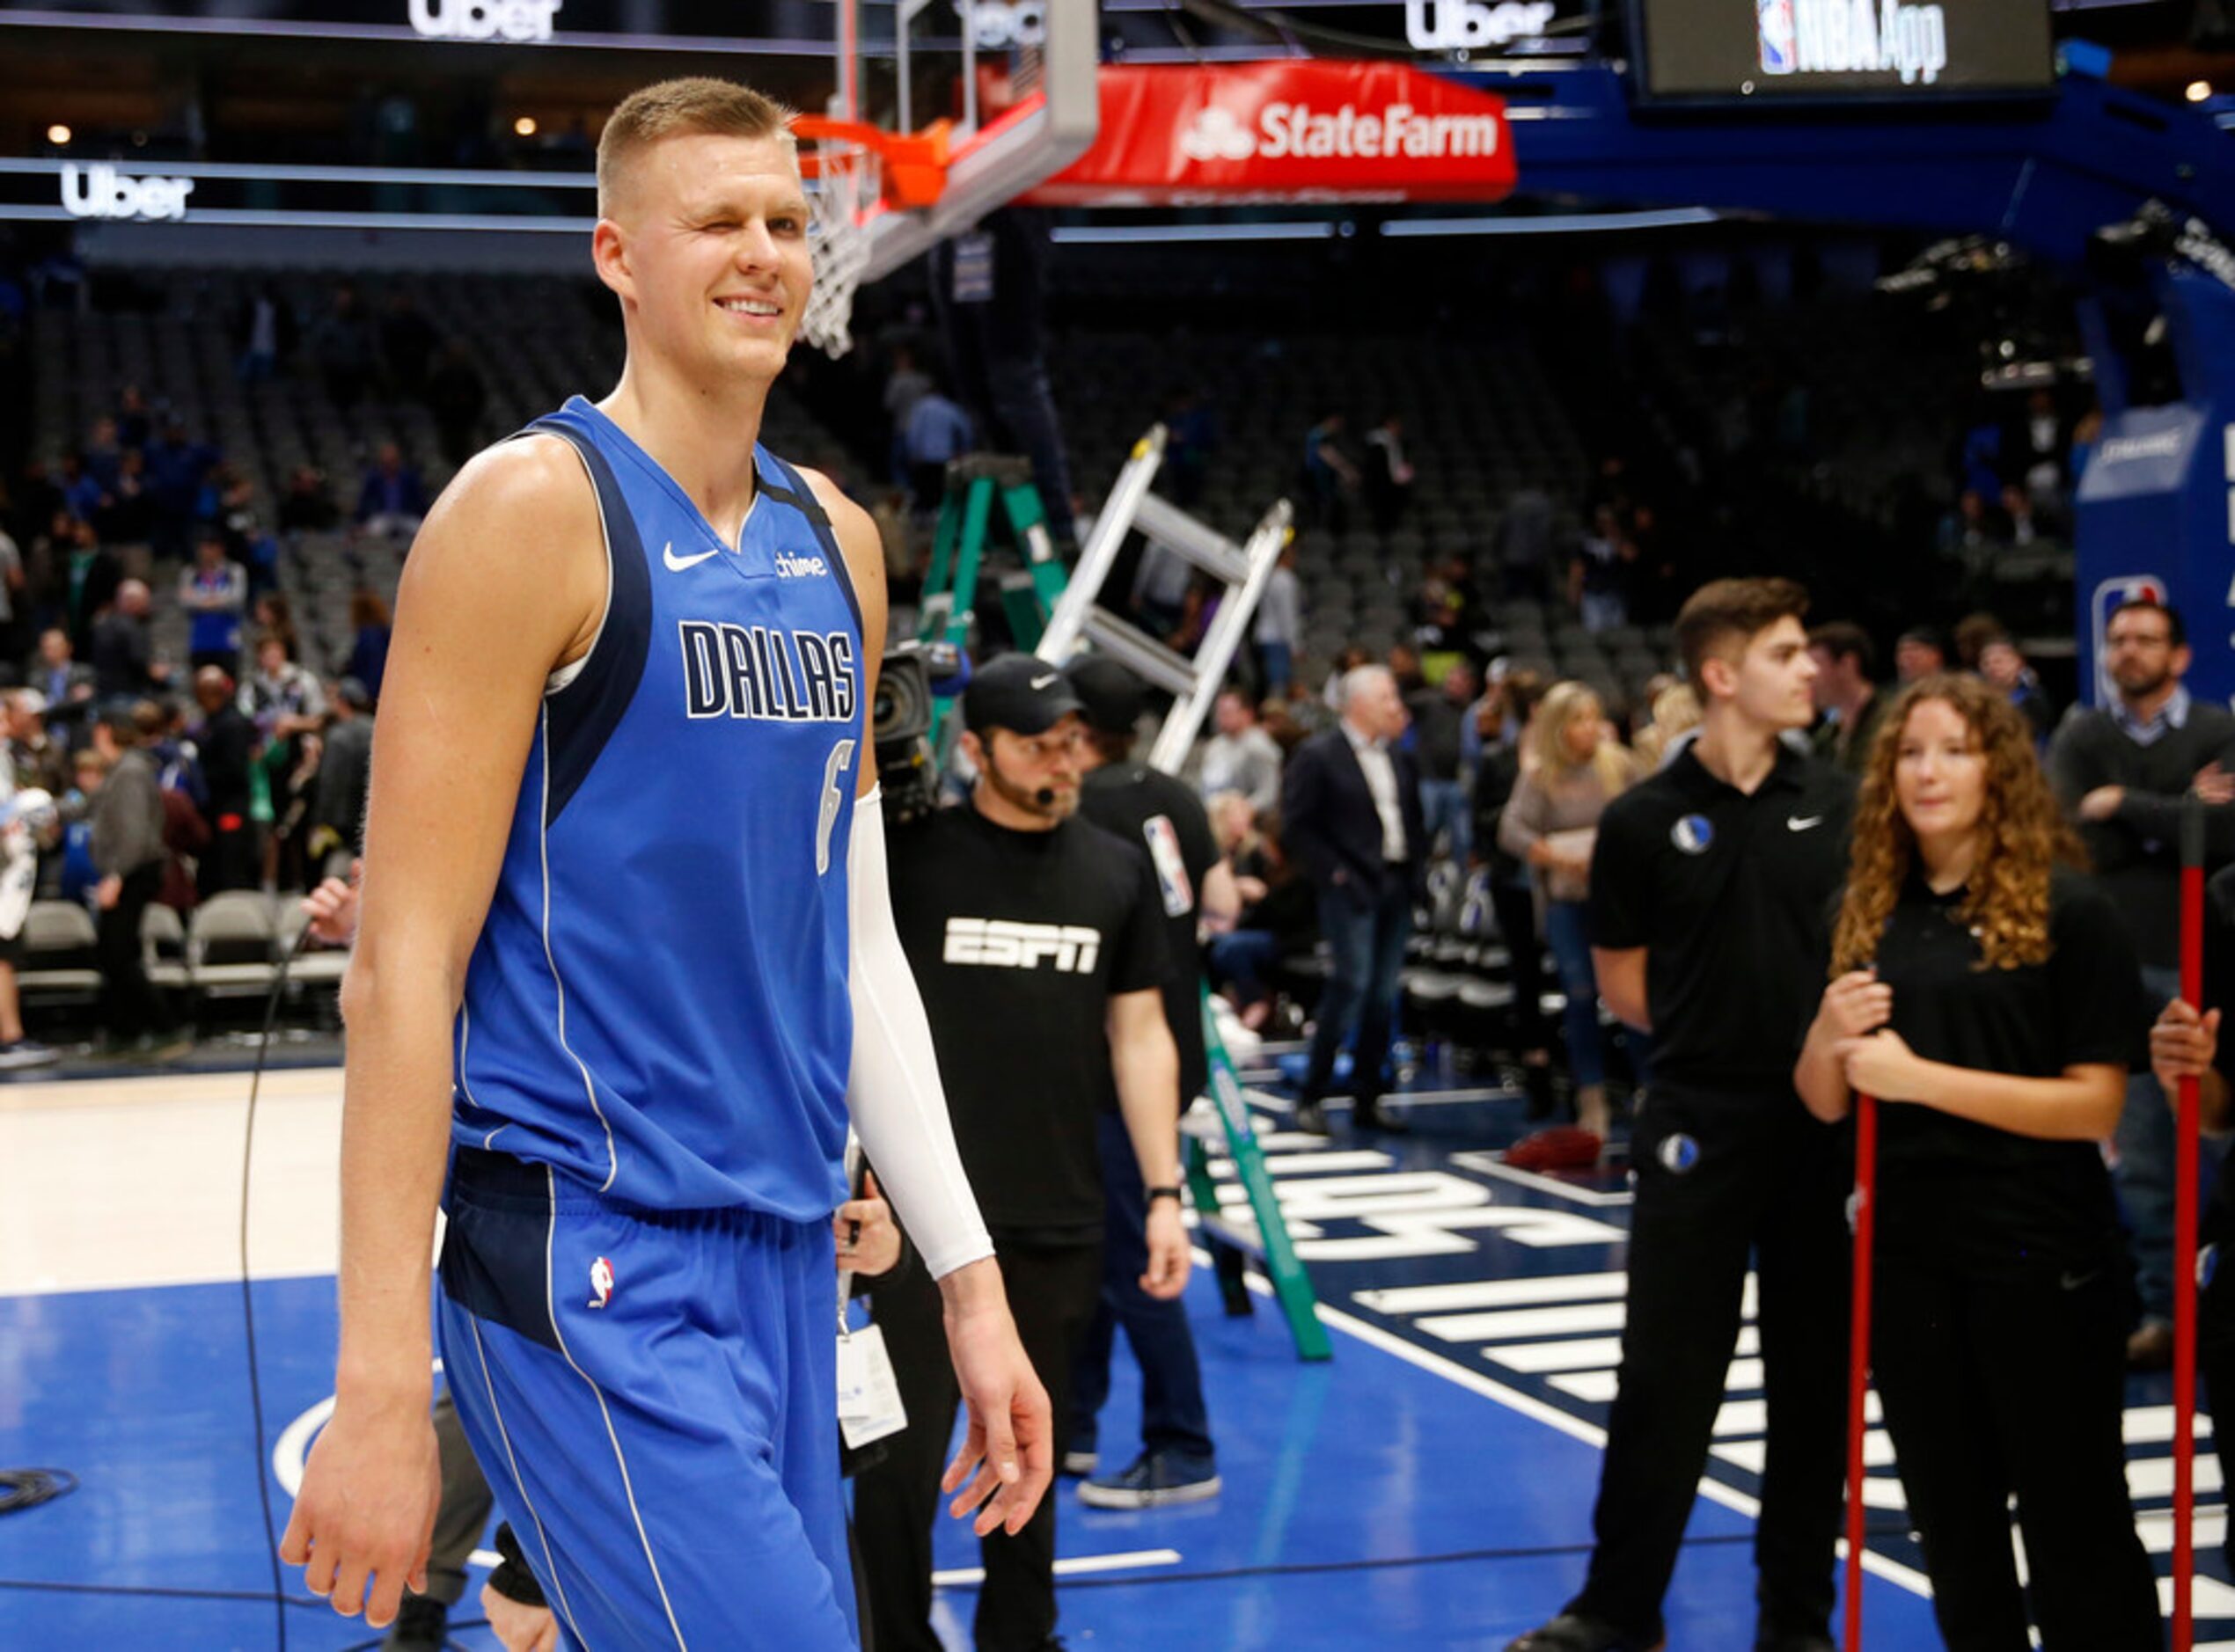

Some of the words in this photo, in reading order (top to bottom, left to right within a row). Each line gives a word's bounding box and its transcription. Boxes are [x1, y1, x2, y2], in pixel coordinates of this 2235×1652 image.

[408, 0, 563, 41] Uber
[1406, 0, 1556, 50] Uber
[61, 162, 195, 220] Uber
[678, 619, 856, 722] DALLAS
[943, 917, 1100, 974] ESPN
